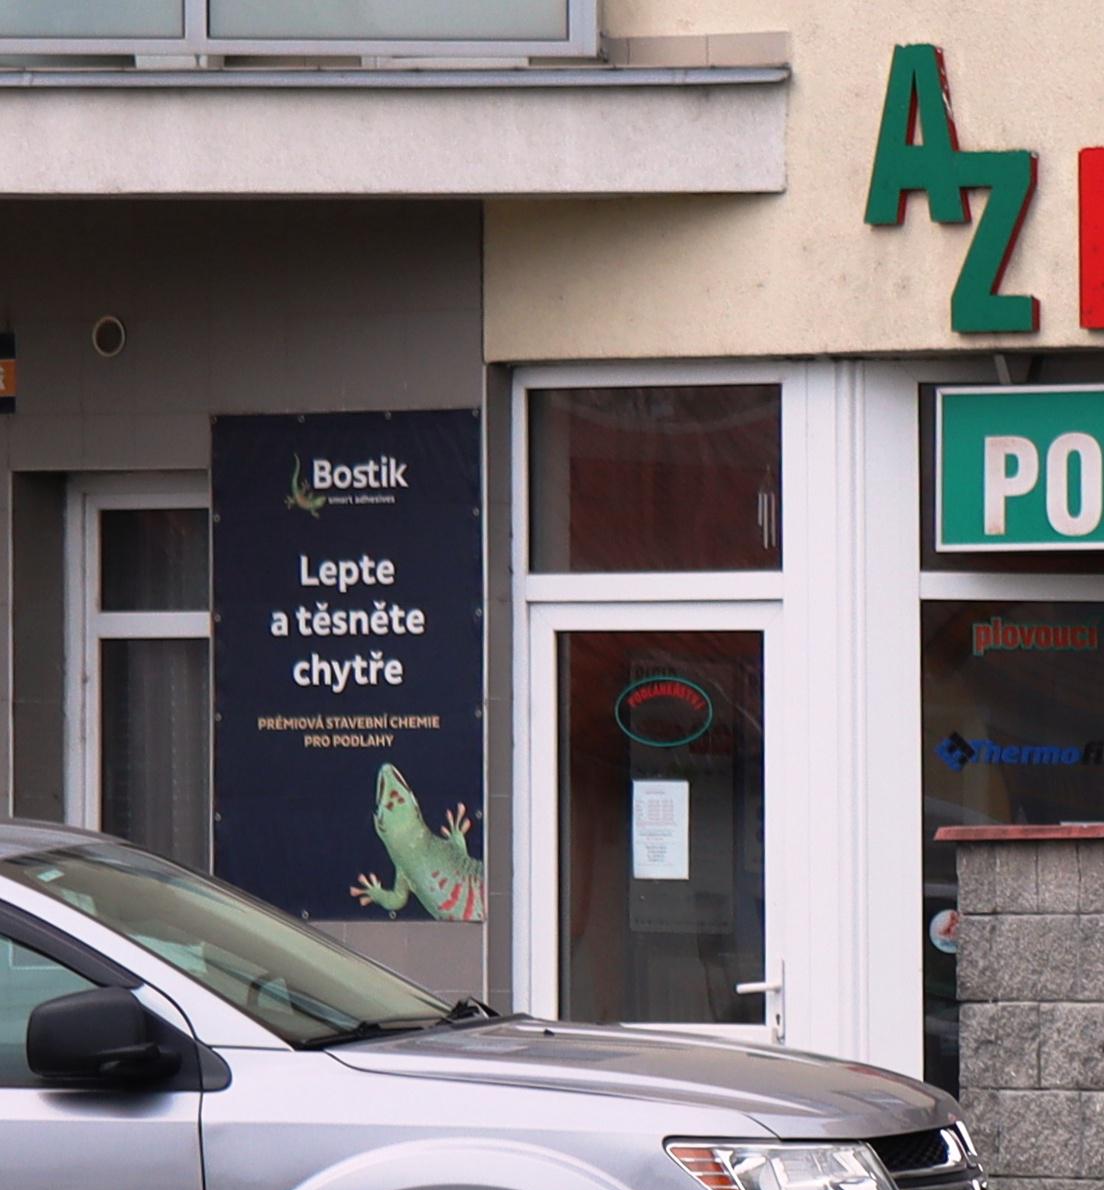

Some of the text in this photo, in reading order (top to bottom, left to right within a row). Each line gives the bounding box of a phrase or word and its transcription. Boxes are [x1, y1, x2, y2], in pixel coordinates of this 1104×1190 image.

[312, 455, 409, 490] Bostik
[300, 554, 396, 593] Lepte
[270, 601, 426, 637] a těsněte
[292, 651, 404, 694] chytře
[257, 713, 441, 731] PRÉMIOVÁ STAVEBNÍ CHEMIE
[304, 734, 395, 748] PRO PODLAHY
